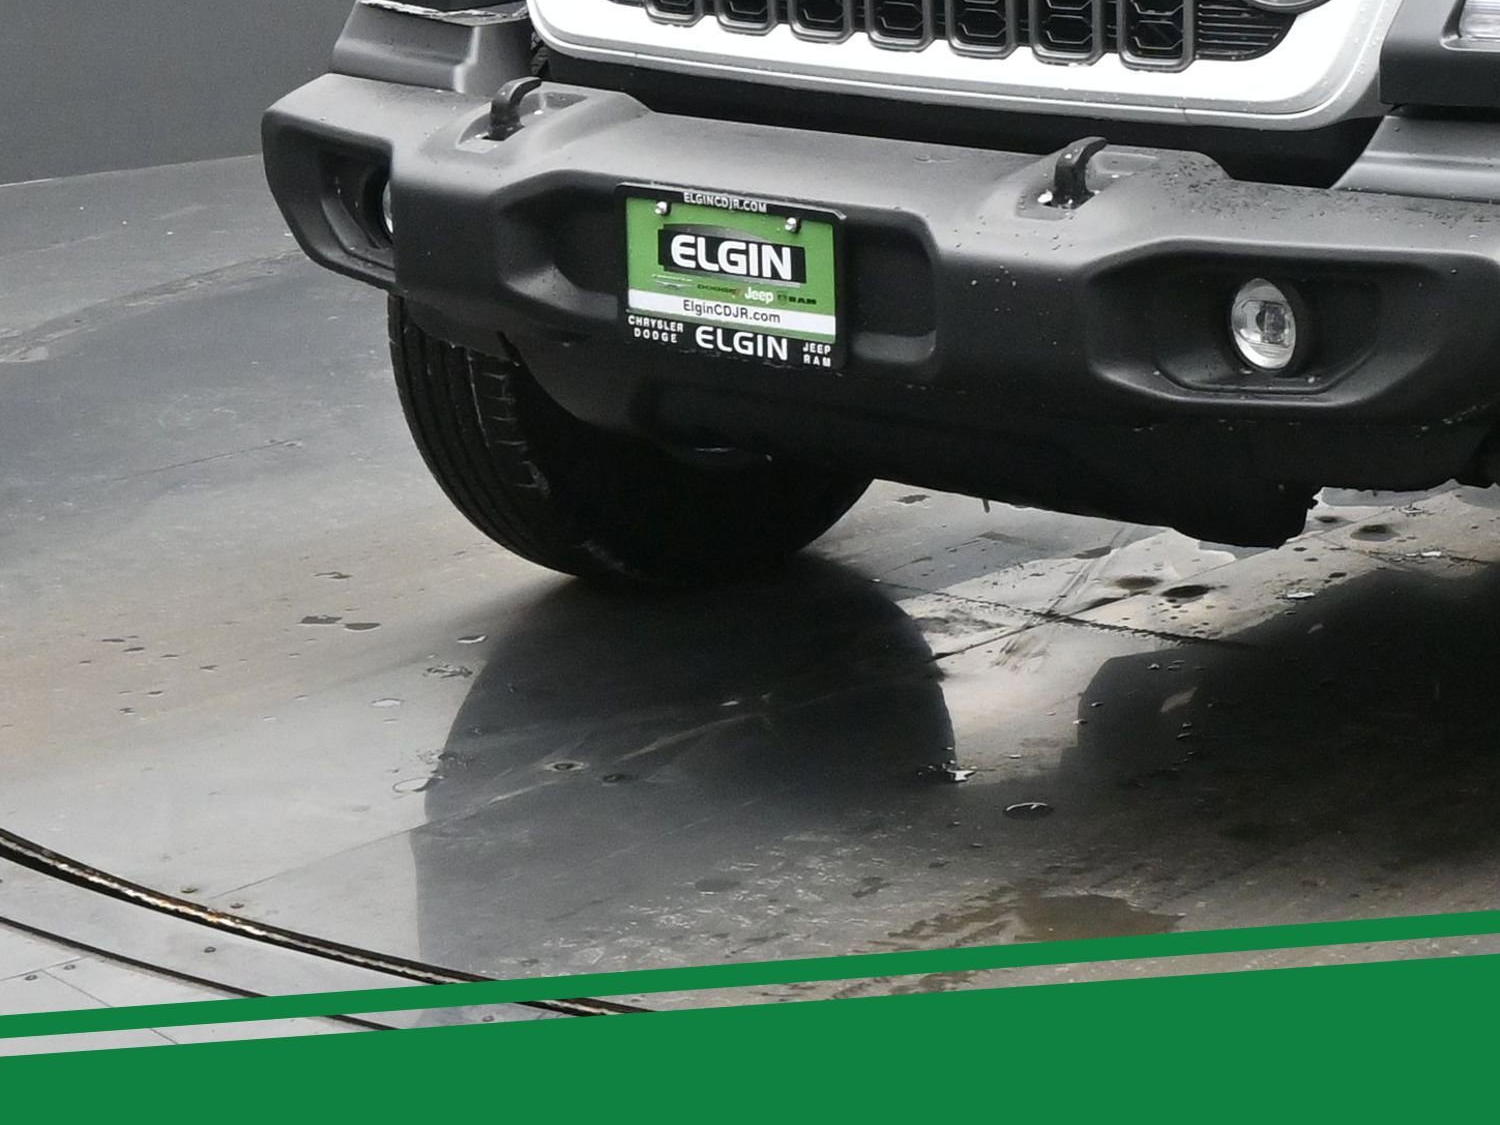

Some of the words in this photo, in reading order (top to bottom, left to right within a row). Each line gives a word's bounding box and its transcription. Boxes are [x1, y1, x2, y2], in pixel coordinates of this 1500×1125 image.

[683, 191, 768, 213] ELGINCDJR.COM
[670, 234, 792, 281] ELGIN
[744, 286, 774, 304] Jeep
[683, 299, 781, 323] ElginCDJR.com
[628, 315, 684, 333] CHRYSLER
[634, 327, 678, 343] DODGE
[695, 326, 788, 361] ELGIN
[803, 341, 831, 354] JEEP
[803, 354, 831, 368] RAM
